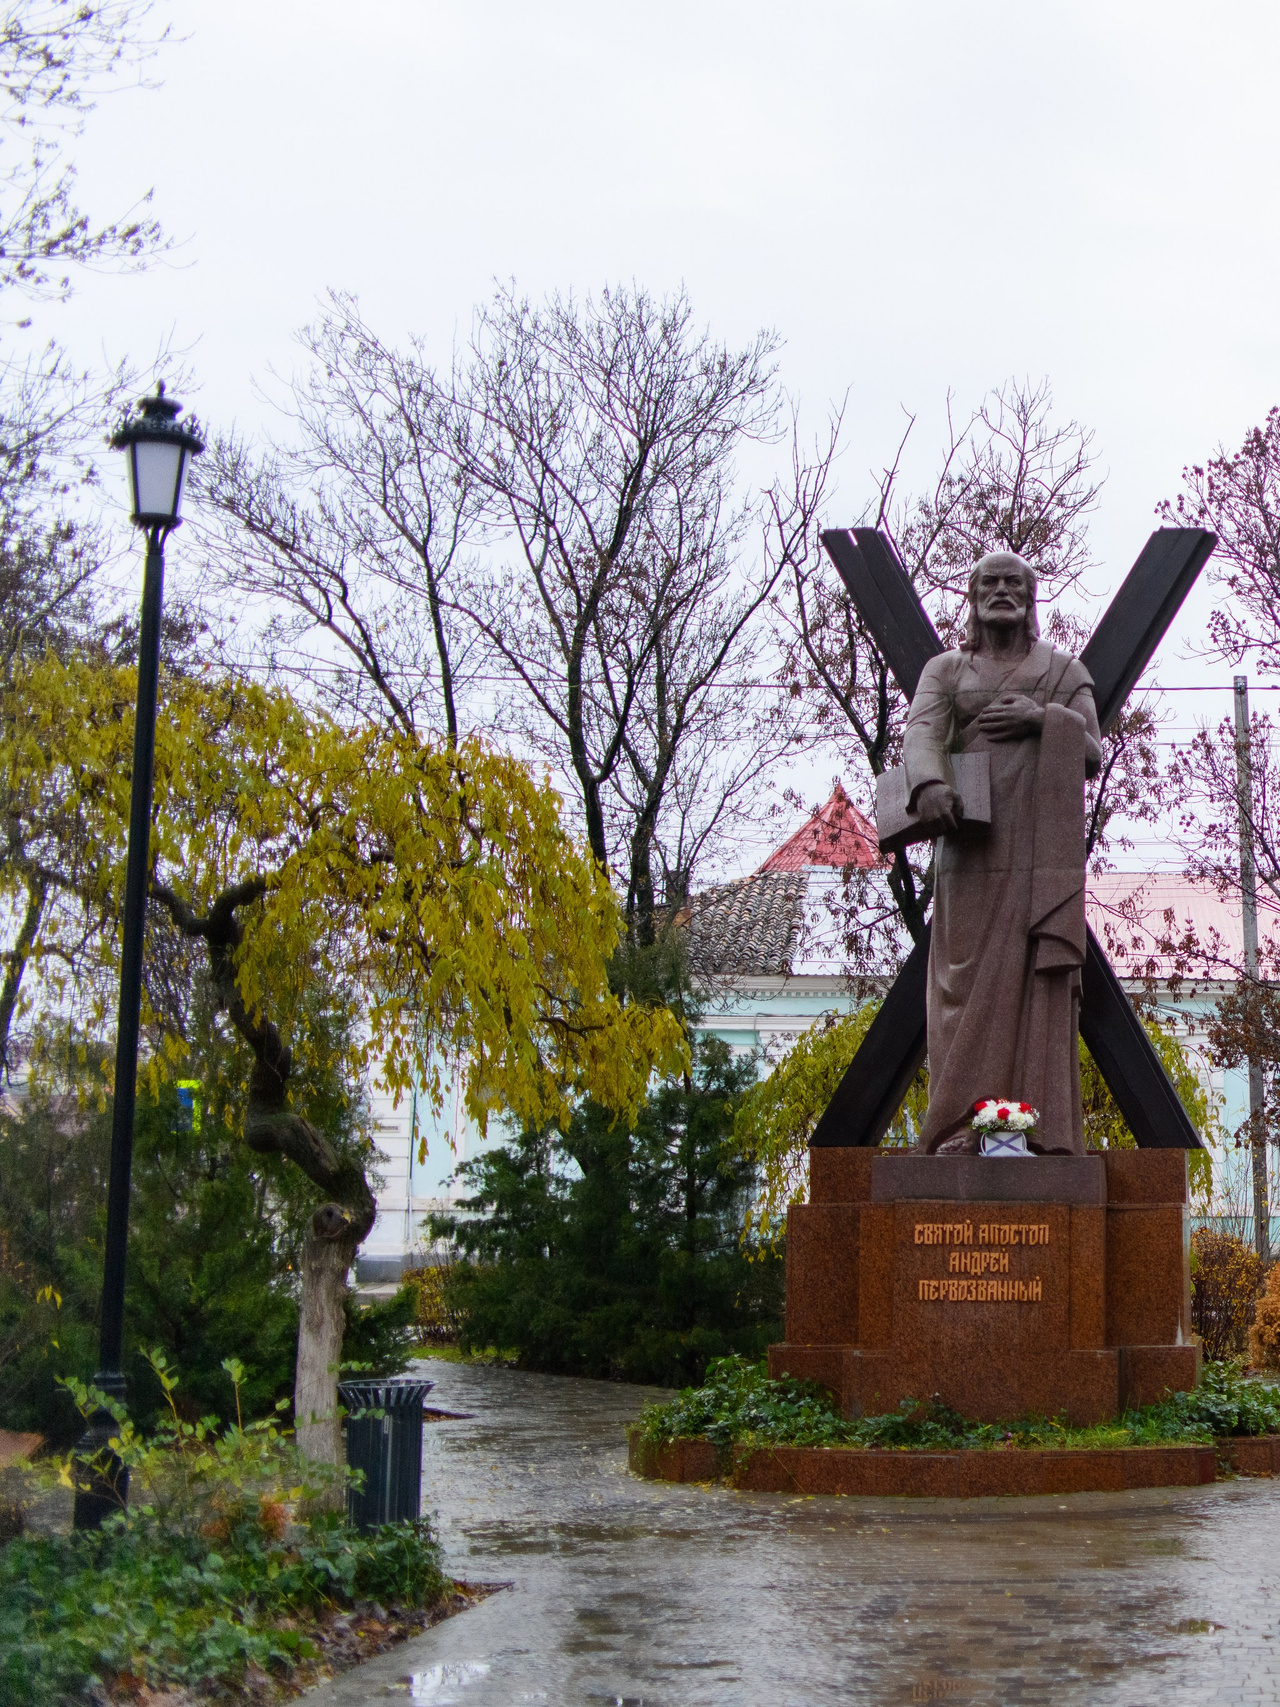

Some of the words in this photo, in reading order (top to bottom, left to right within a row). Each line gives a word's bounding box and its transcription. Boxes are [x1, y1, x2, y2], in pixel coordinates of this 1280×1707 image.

[914, 1219, 973, 1245] СВЯТОЙ
[979, 1224, 1050, 1246] АПОСТОЛ
[949, 1248, 1009, 1276] АНДРЕЙ
[918, 1276, 1042, 1301] ПЕРВОЗВАННЫЙ
